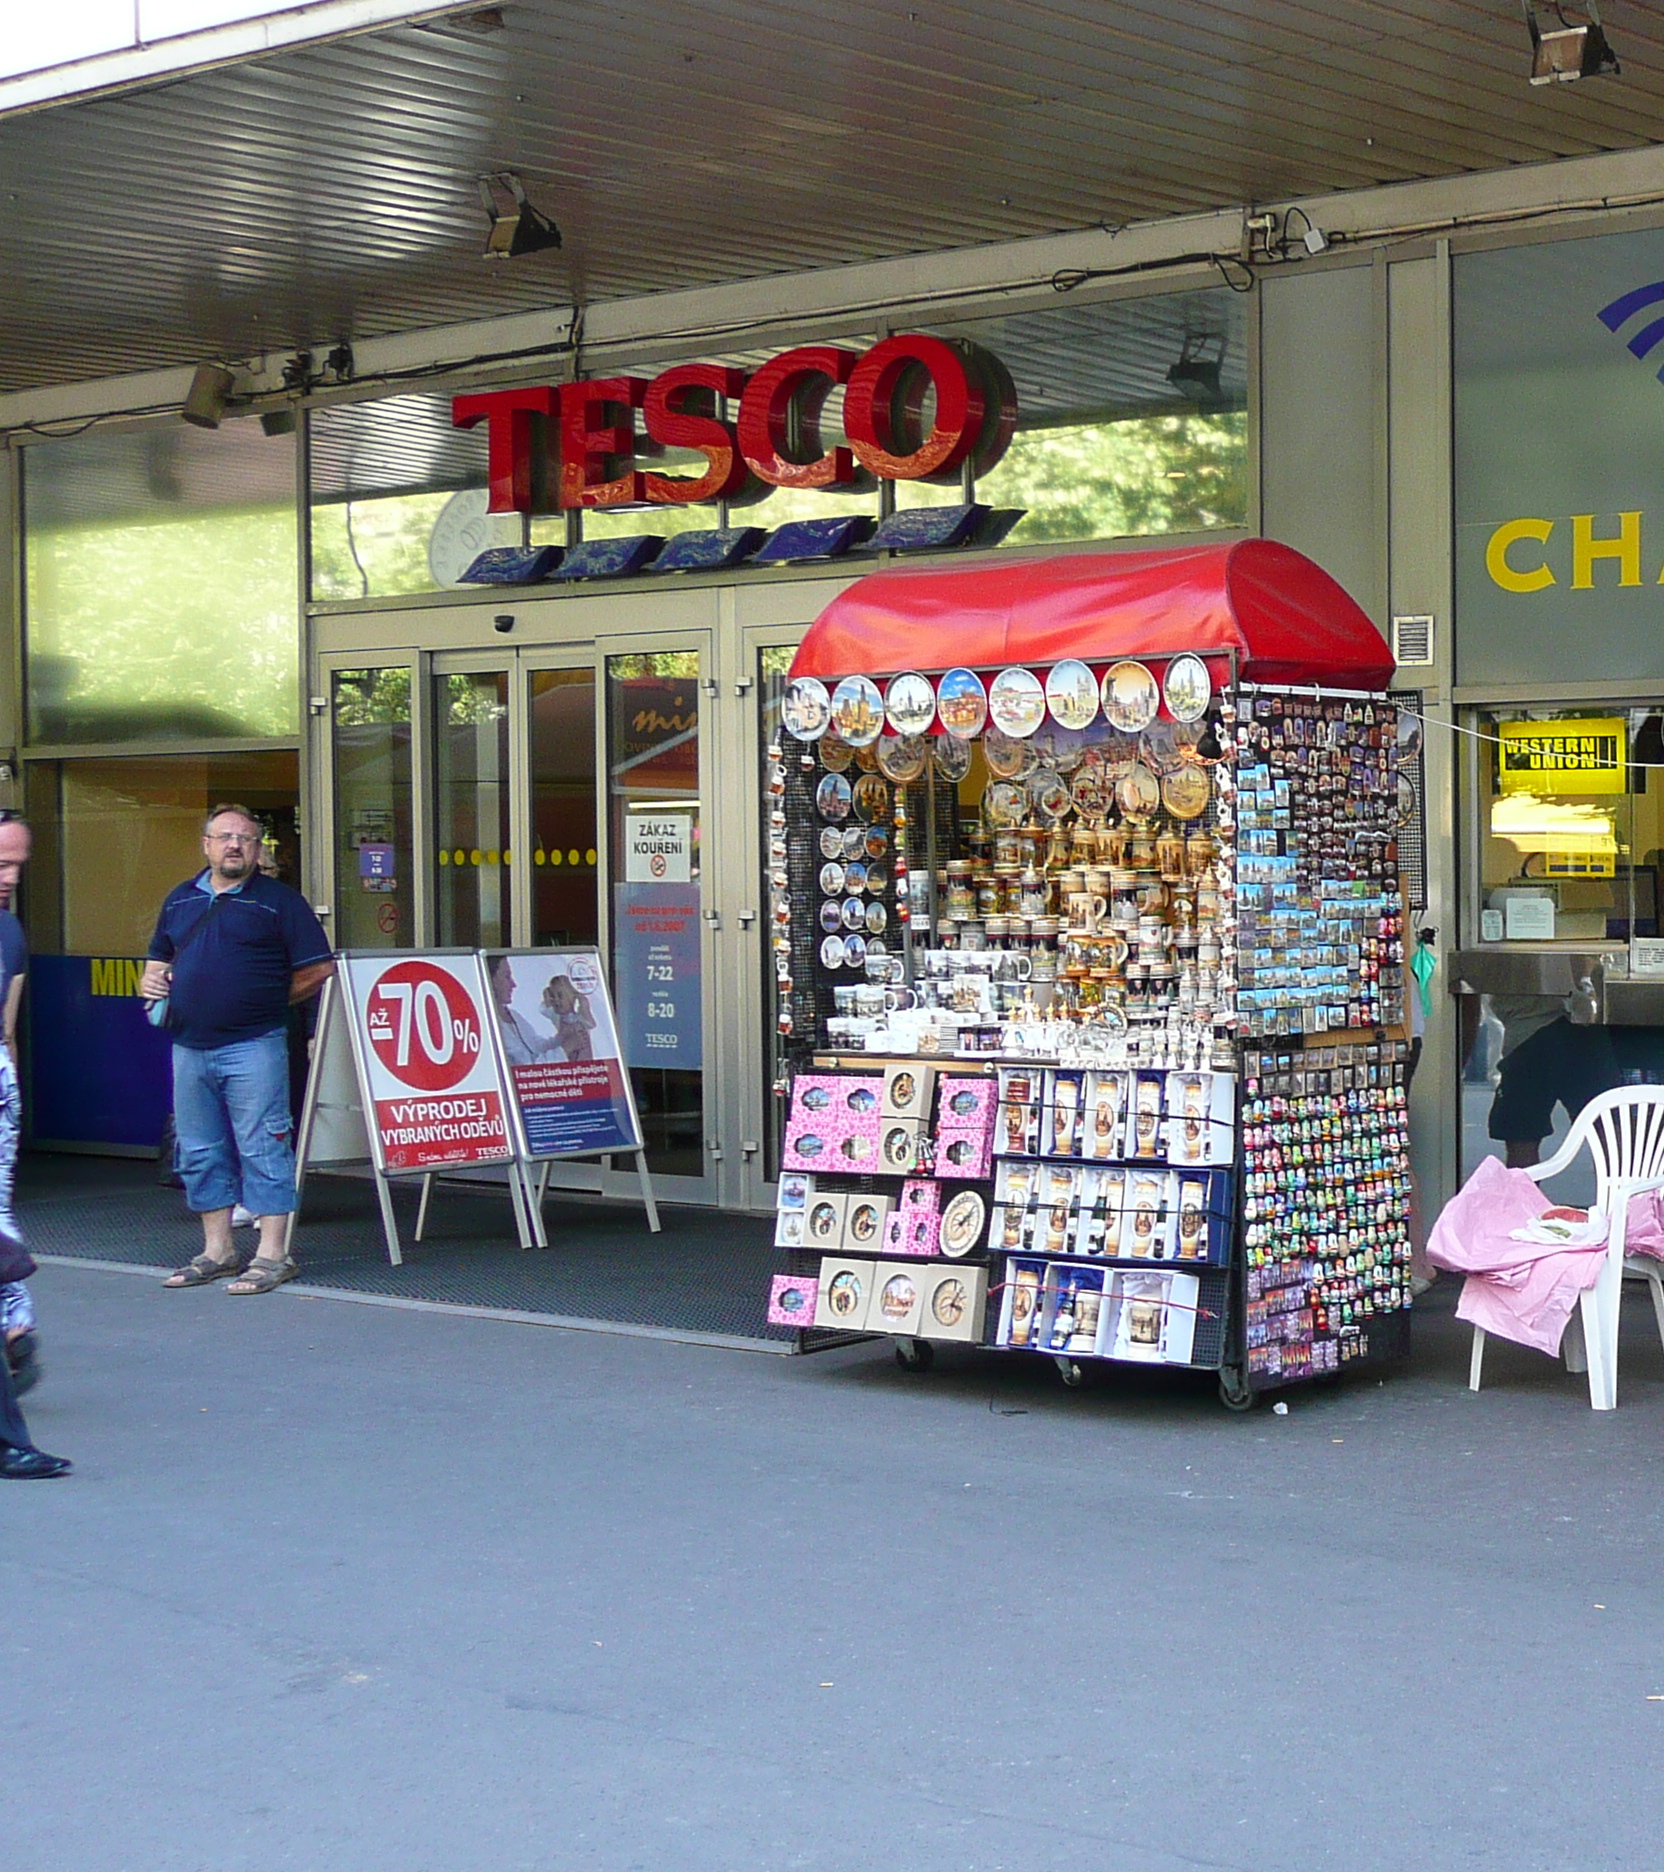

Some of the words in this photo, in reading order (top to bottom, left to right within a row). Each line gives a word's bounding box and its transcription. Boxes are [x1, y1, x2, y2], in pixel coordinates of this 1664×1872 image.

[452, 333, 986, 514] TESCO
[1506, 738, 1595, 754] WESTERN
[1530, 754, 1595, 769] UNION
[639, 820, 676, 837] ZÁKAZ
[633, 838, 683, 854] KOUŘENÍ
[647, 966, 673, 980] 7-22
[370, 1008, 390, 1026] AŽ
[647, 1003, 674, 1017] 8-20
[645, 1033, 677, 1044] TESCO
[391, 1098, 487, 1123] VÝPRODEJ
[380, 1120, 460, 1146] VYBRANÝCH
[460, 1114, 504, 1139] ODĚVŮ
[476, 1146, 508, 1156] TESCO
